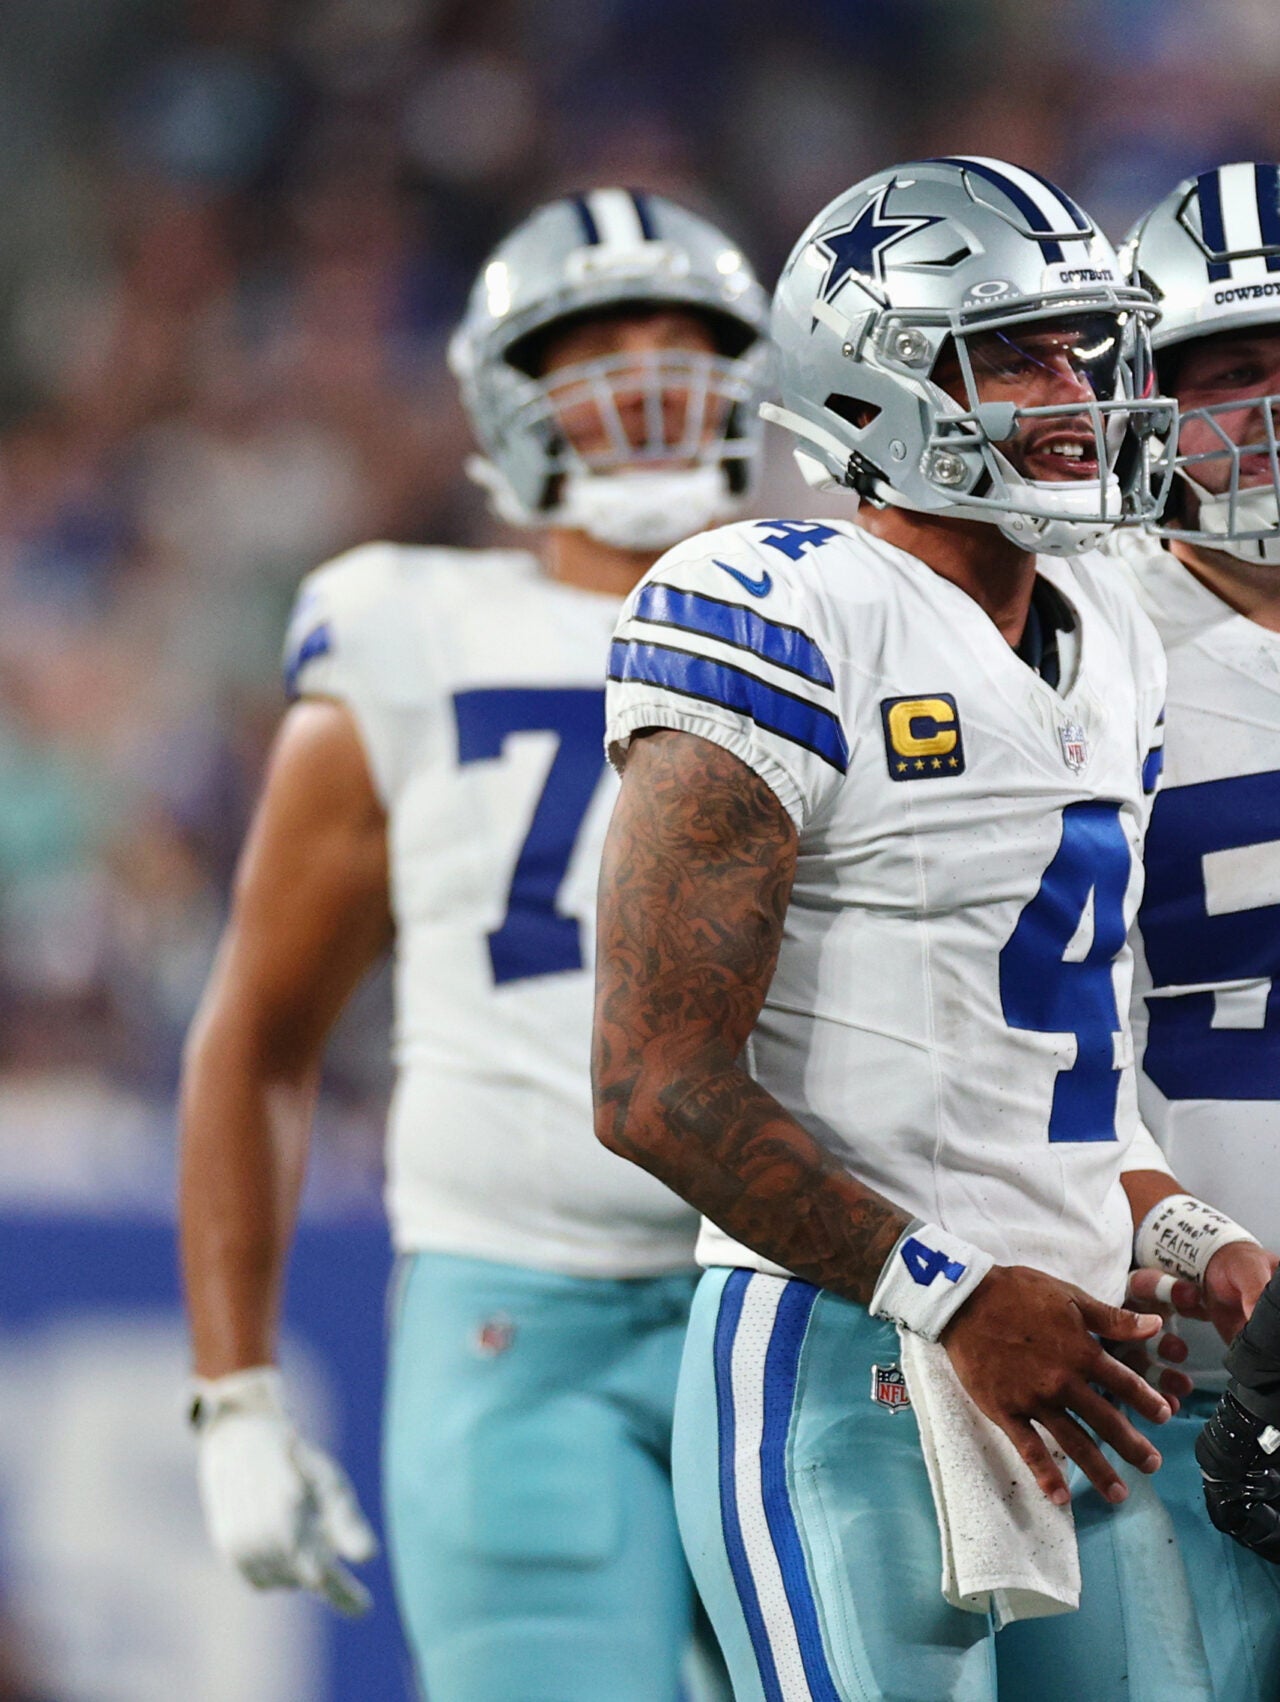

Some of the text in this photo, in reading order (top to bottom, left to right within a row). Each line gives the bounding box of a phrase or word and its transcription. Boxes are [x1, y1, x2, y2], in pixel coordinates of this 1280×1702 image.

[888, 698, 957, 757] C
[998, 800, 1133, 1143] 4
[900, 1236, 967, 1287] 4
[1160, 1228, 1200, 1263] FAITH
